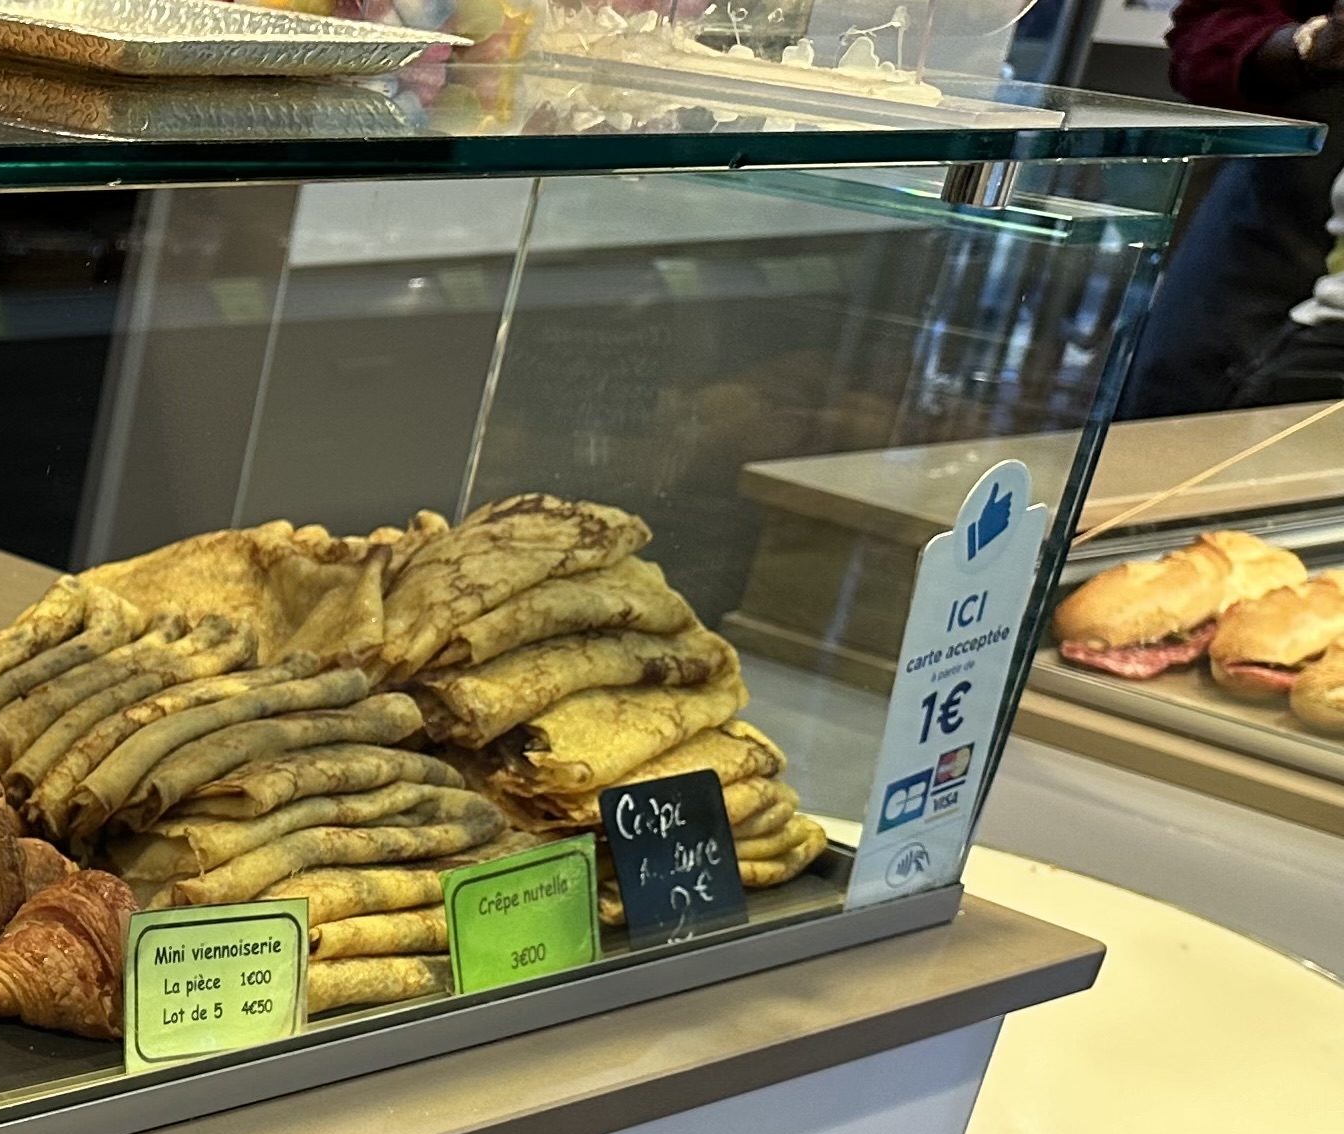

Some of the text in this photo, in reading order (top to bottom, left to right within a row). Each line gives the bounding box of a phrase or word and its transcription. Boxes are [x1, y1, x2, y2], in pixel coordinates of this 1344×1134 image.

[947, 590, 988, 632] ICI
[906, 624, 1010, 673] carte acceptée
[919, 680, 972, 744] 1€
[478, 874, 569, 916] Crêpe nutella
[155, 936, 282, 966] Mini viennoiserie
[510, 942, 546, 969] 3€00
[164, 970, 272, 997] La pièce 1€00
[163, 999, 273, 1025] Lot de 5 4€50
